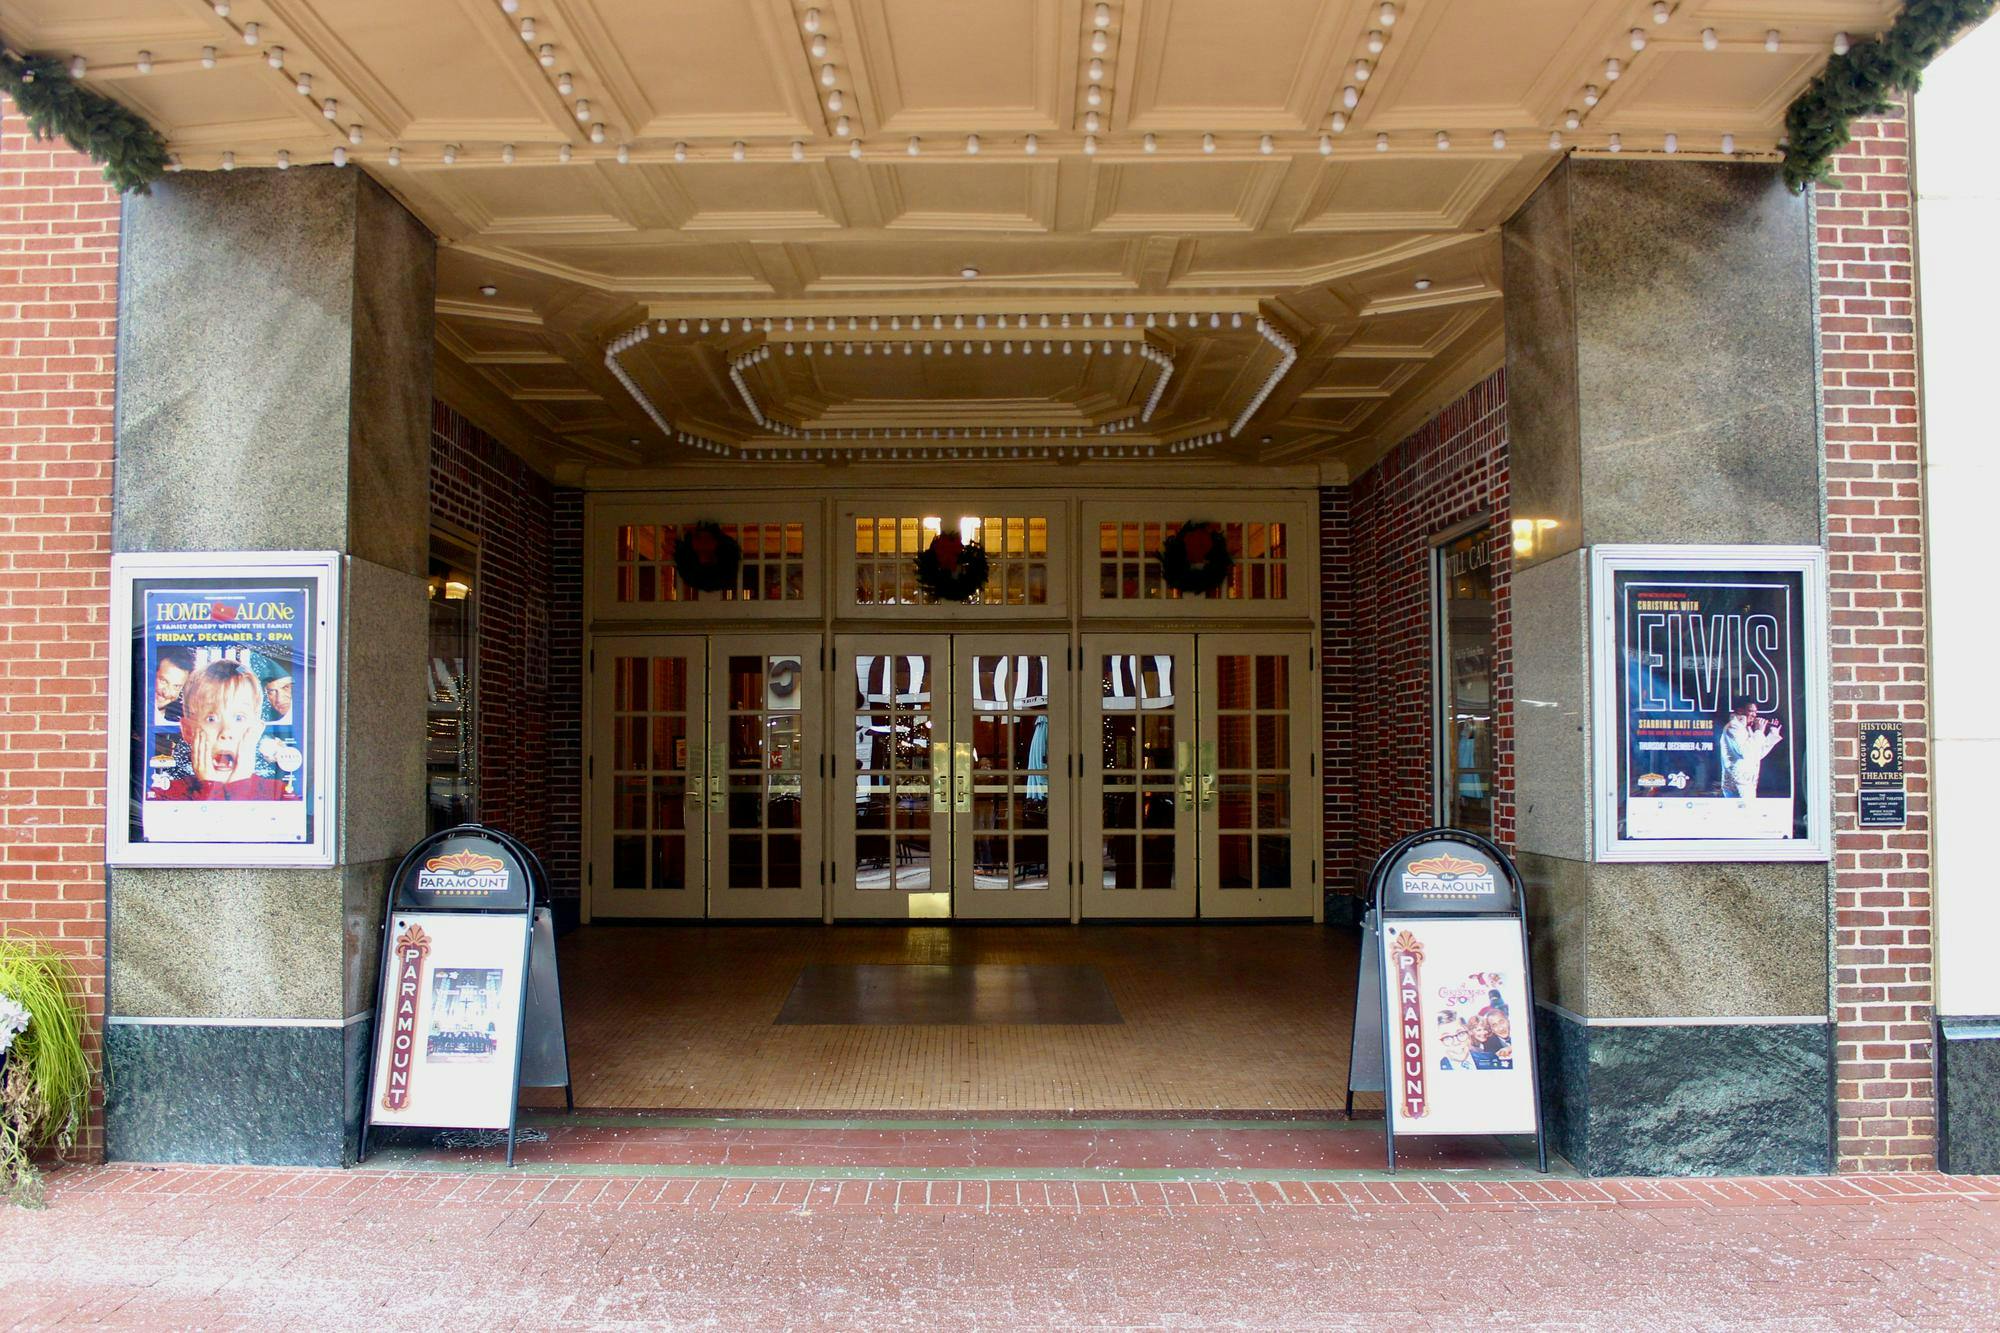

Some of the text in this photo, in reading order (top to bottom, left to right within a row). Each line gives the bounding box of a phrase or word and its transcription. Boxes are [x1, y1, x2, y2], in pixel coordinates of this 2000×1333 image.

[1637, 600, 1699, 611] CHRISTMAS WITH
[156, 602, 211, 621] HOME
[156, 633, 196, 643] FRIDAY,
[198, 632, 253, 642] DECEMBER
[268, 632, 293, 641] 8PM
[1638, 613, 1780, 714] ELVIS
[1638, 719, 1714, 730] STARRING MATT LEWIS
[1860, 722, 1903, 731] HISTORIC
[1860, 731, 1867, 740] OF
[1861, 772, 1904, 780] THEATRES
[420, 877, 507, 888] PARAMOUNT
[1405, 881, 1493, 892] PARAMOUNT
[390, 949, 420, 1104] PARAMOUNT
[1400, 956, 1423, 1113] PARAMOUNT
